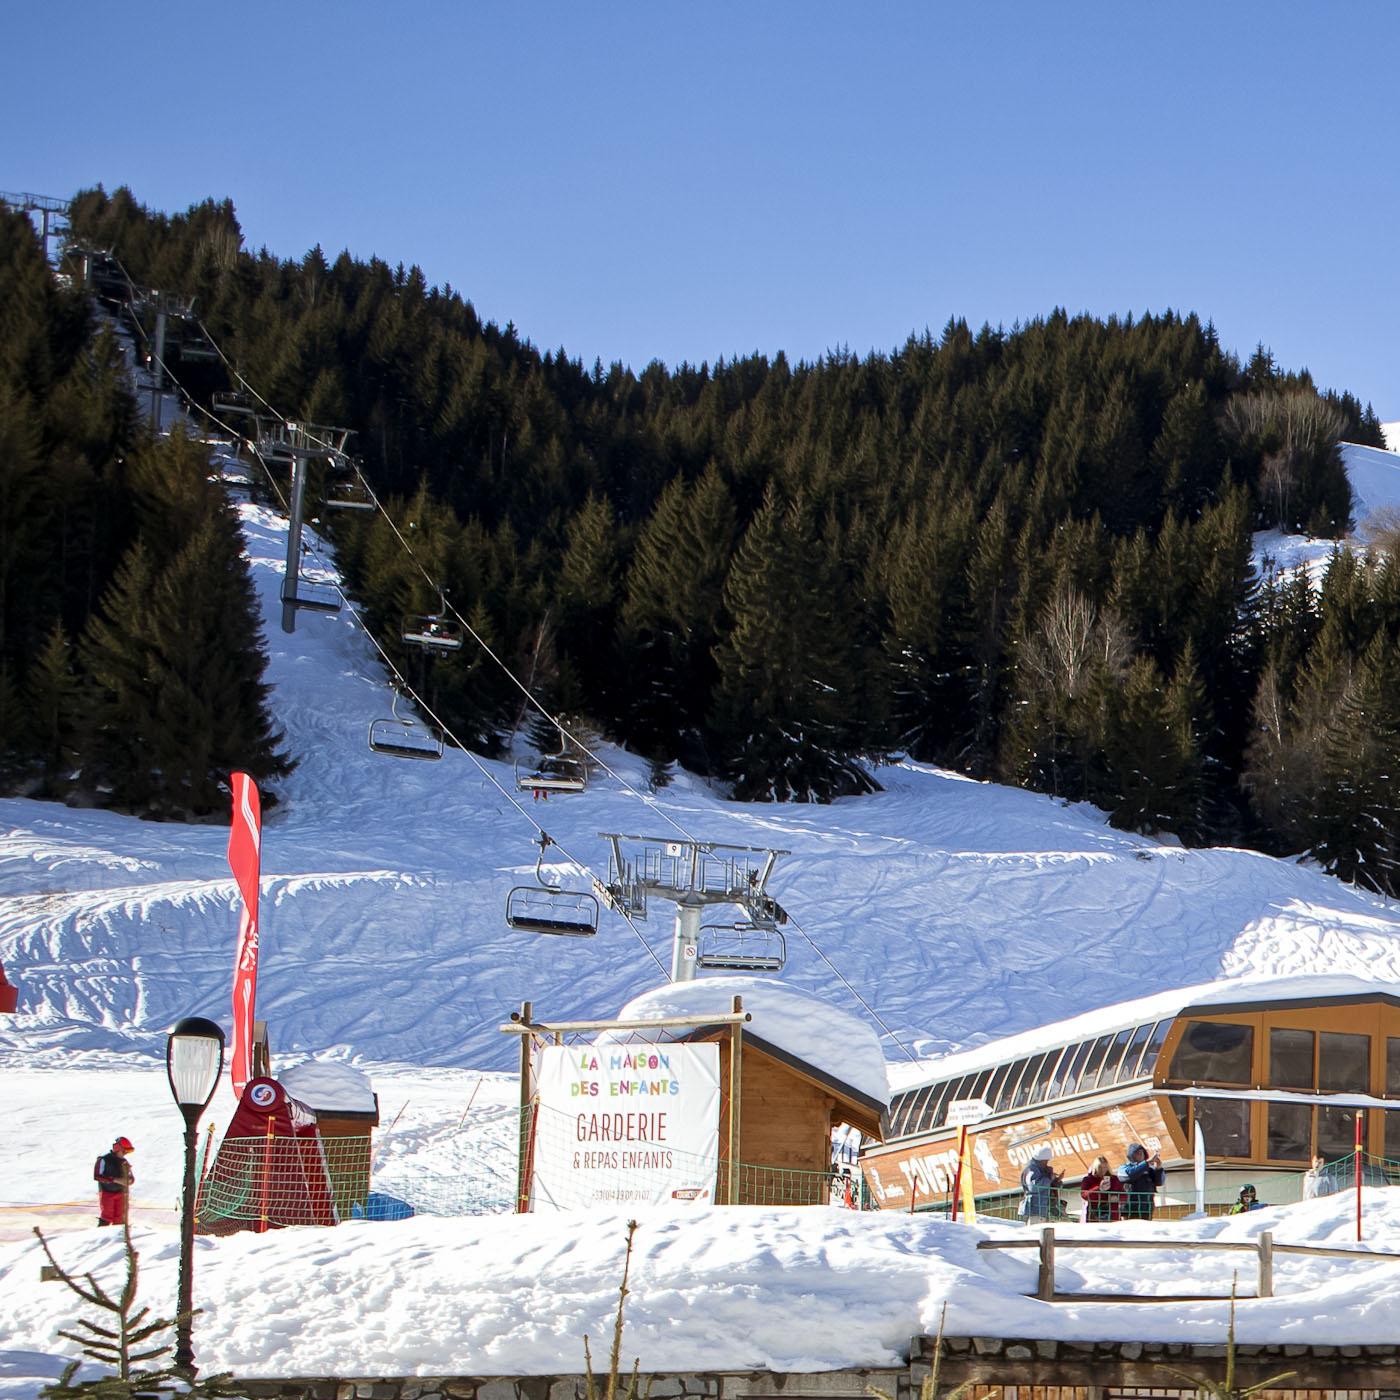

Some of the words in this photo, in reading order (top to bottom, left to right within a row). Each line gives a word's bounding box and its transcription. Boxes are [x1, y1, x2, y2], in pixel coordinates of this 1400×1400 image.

[580, 1053, 599, 1071] LA
[610, 1053, 669, 1071] MAISON
[571, 1080, 599, 1097] DES
[610, 1080, 680, 1097] ENFANTS
[577, 1112, 668, 1142] GARDERIE
[573, 1152, 581, 1169] &
[584, 1151, 619, 1169] REPAS
[622, 1150, 674, 1169] ENFANTS
